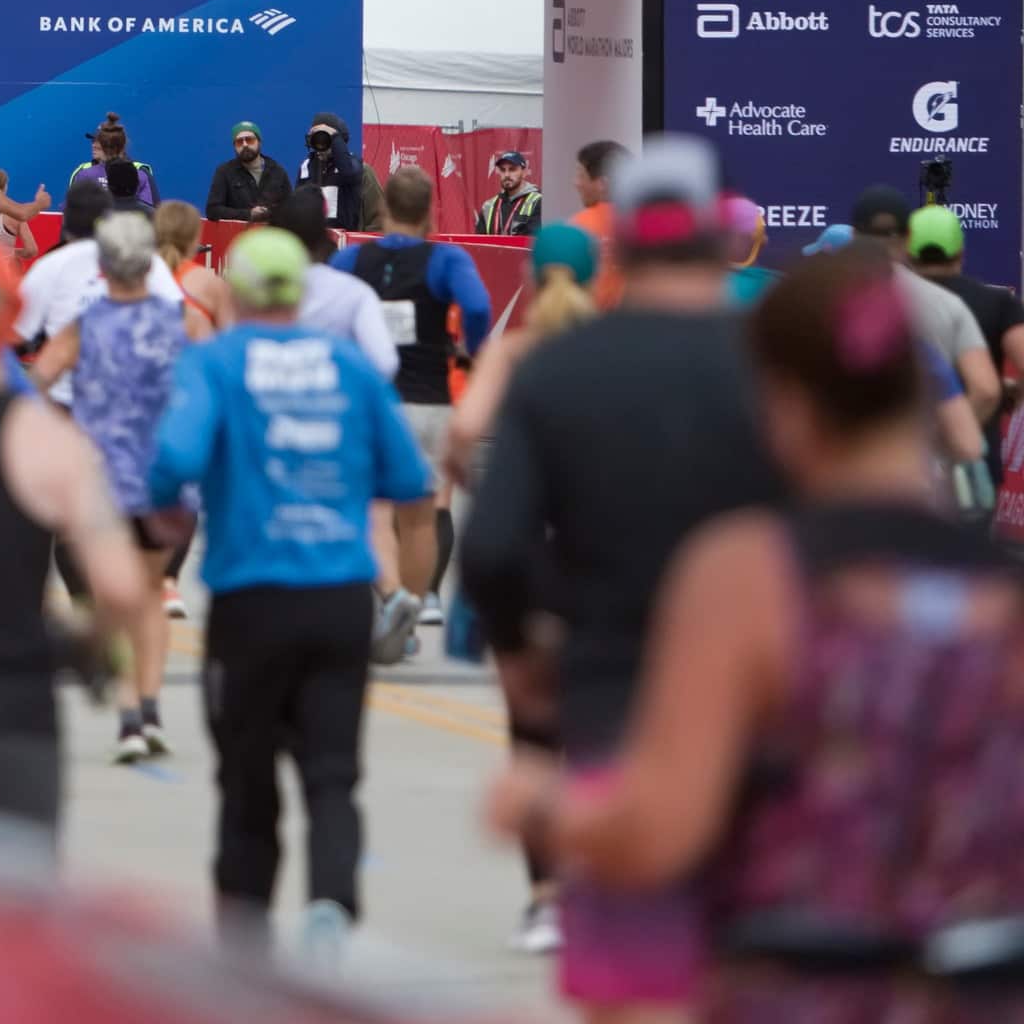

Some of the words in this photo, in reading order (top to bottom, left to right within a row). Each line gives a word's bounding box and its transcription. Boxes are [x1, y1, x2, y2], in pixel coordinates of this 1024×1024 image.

[926, 5, 959, 14] TATA
[40, 17, 100, 31] BANK
[108, 17, 136, 32] OF
[142, 18, 243, 33] AMERICA
[747, 12, 828, 30] Abbott
[926, 16, 1001, 26] CONSULTANCY
[926, 28, 975, 38] SERVICES
[729, 101, 806, 119] Advocate
[728, 120, 783, 136] Health
[787, 121, 827, 136] Care
[889, 137, 990, 153] ENDURANCE
[960, 219, 998, 229] ATHON
